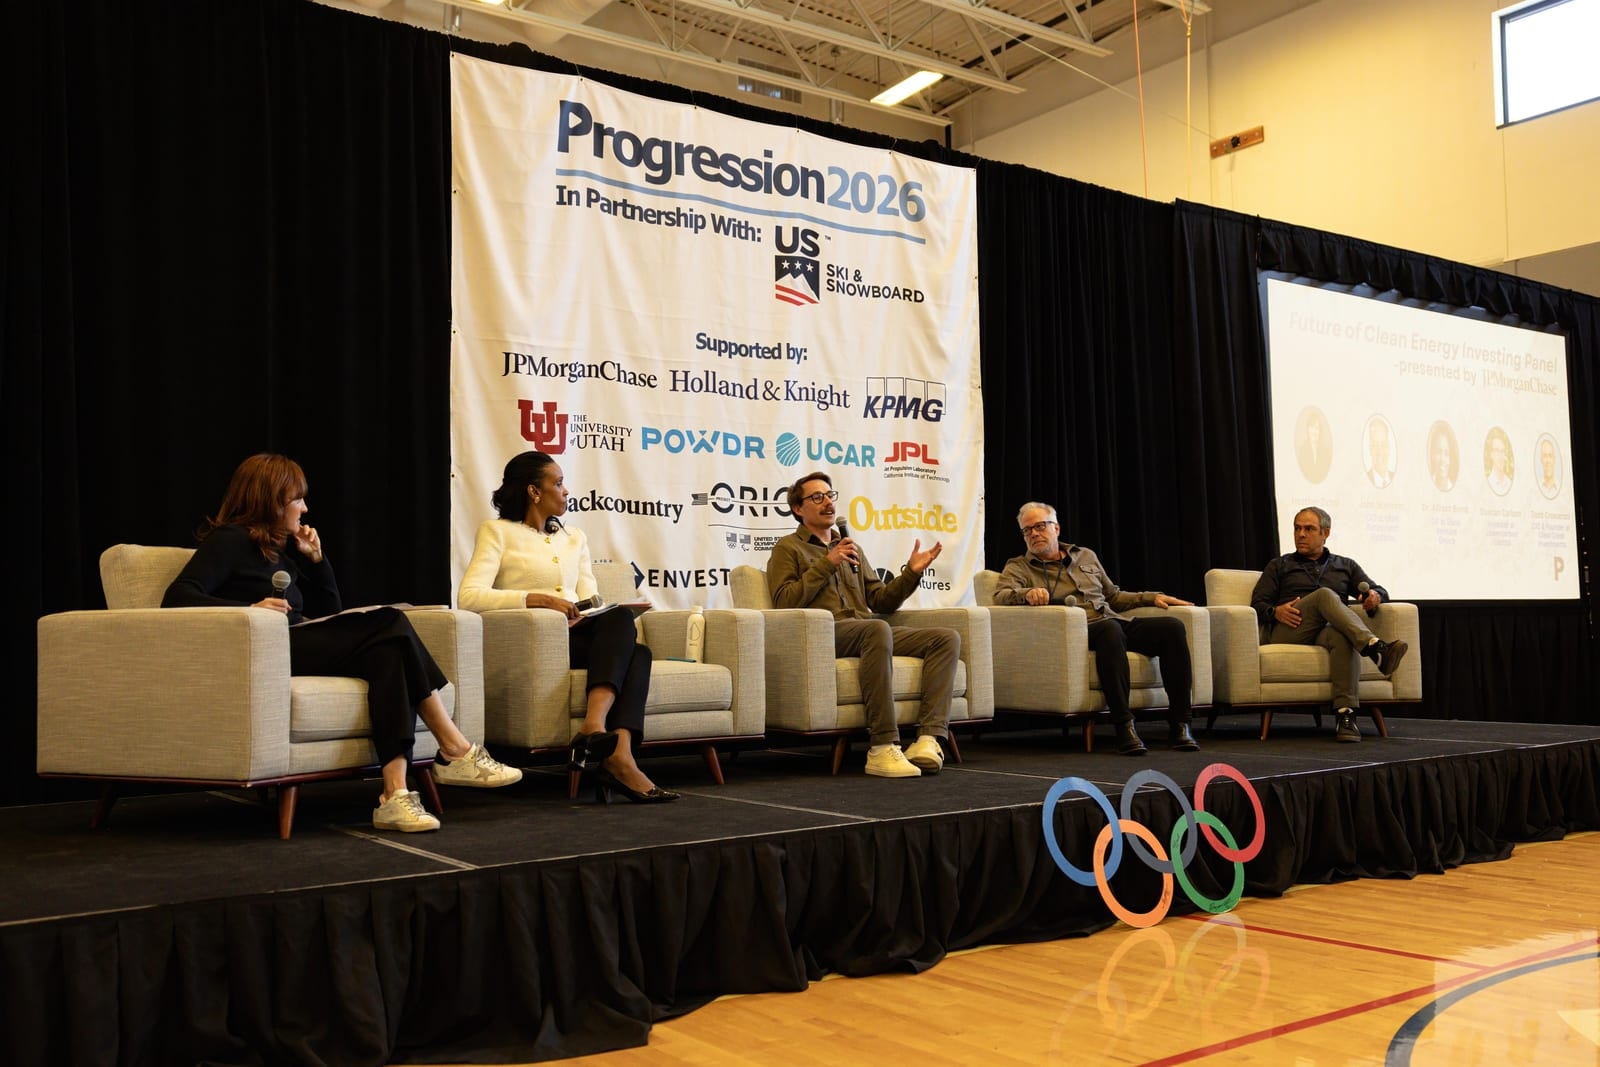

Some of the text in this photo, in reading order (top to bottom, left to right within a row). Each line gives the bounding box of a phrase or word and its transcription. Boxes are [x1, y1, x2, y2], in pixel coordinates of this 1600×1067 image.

[556, 99, 926, 222] Progression2026
[556, 185, 762, 242] In Partnership With:
[775, 226, 820, 257] US
[826, 263, 862, 283] SKI &
[826, 278, 924, 304] SNOWBOARD
[695, 332, 808, 364] Supported by:
[1289, 311, 1557, 374] Future of Clean Energy Investing Panel
[501, 352, 657, 388] JPMorganChase
[1464, 368, 1476, 386] by
[1482, 369, 1557, 396] JPMorganChase
[669, 369, 851, 411] Holland & Knight
[863, 395, 945, 422] KPMG
[570, 423, 633, 437] UNIVERSITY
[577, 434, 625, 452] UTAH
[641, 427, 765, 460] POWDR
[806, 438, 876, 467] UCAR
[884, 442, 940, 465] JPL
[567, 489, 684, 524] ackcountry
[849, 495, 958, 534] Outside
[1553, 556, 1564, 581] P
[920, 579, 951, 591] tures
